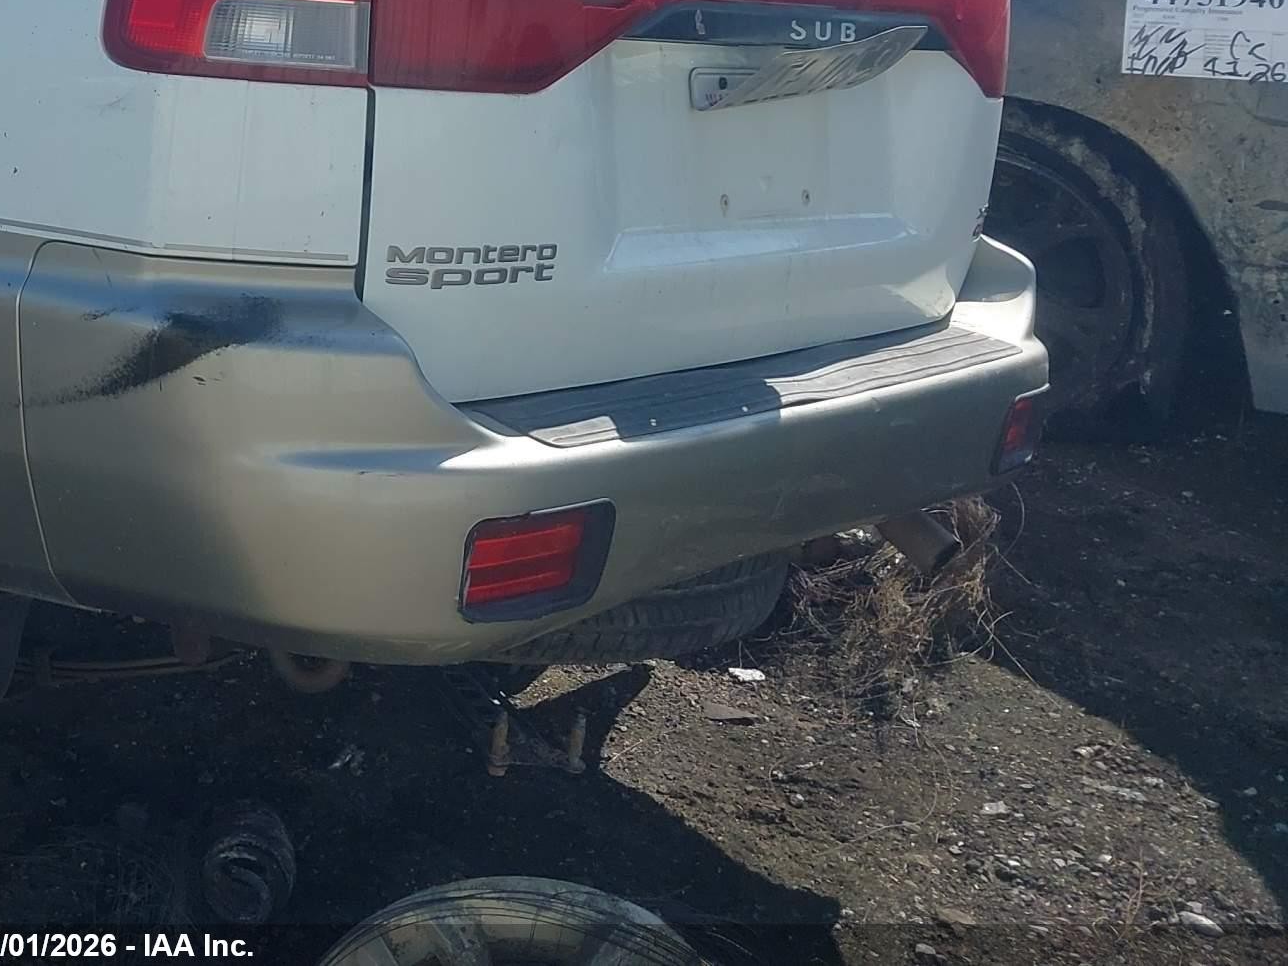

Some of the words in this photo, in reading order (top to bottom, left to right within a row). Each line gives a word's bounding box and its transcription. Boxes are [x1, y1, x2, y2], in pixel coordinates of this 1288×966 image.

[790, 20, 856, 42] SUB
[386, 244, 557, 264] Montero
[385, 263, 555, 290] Sport
